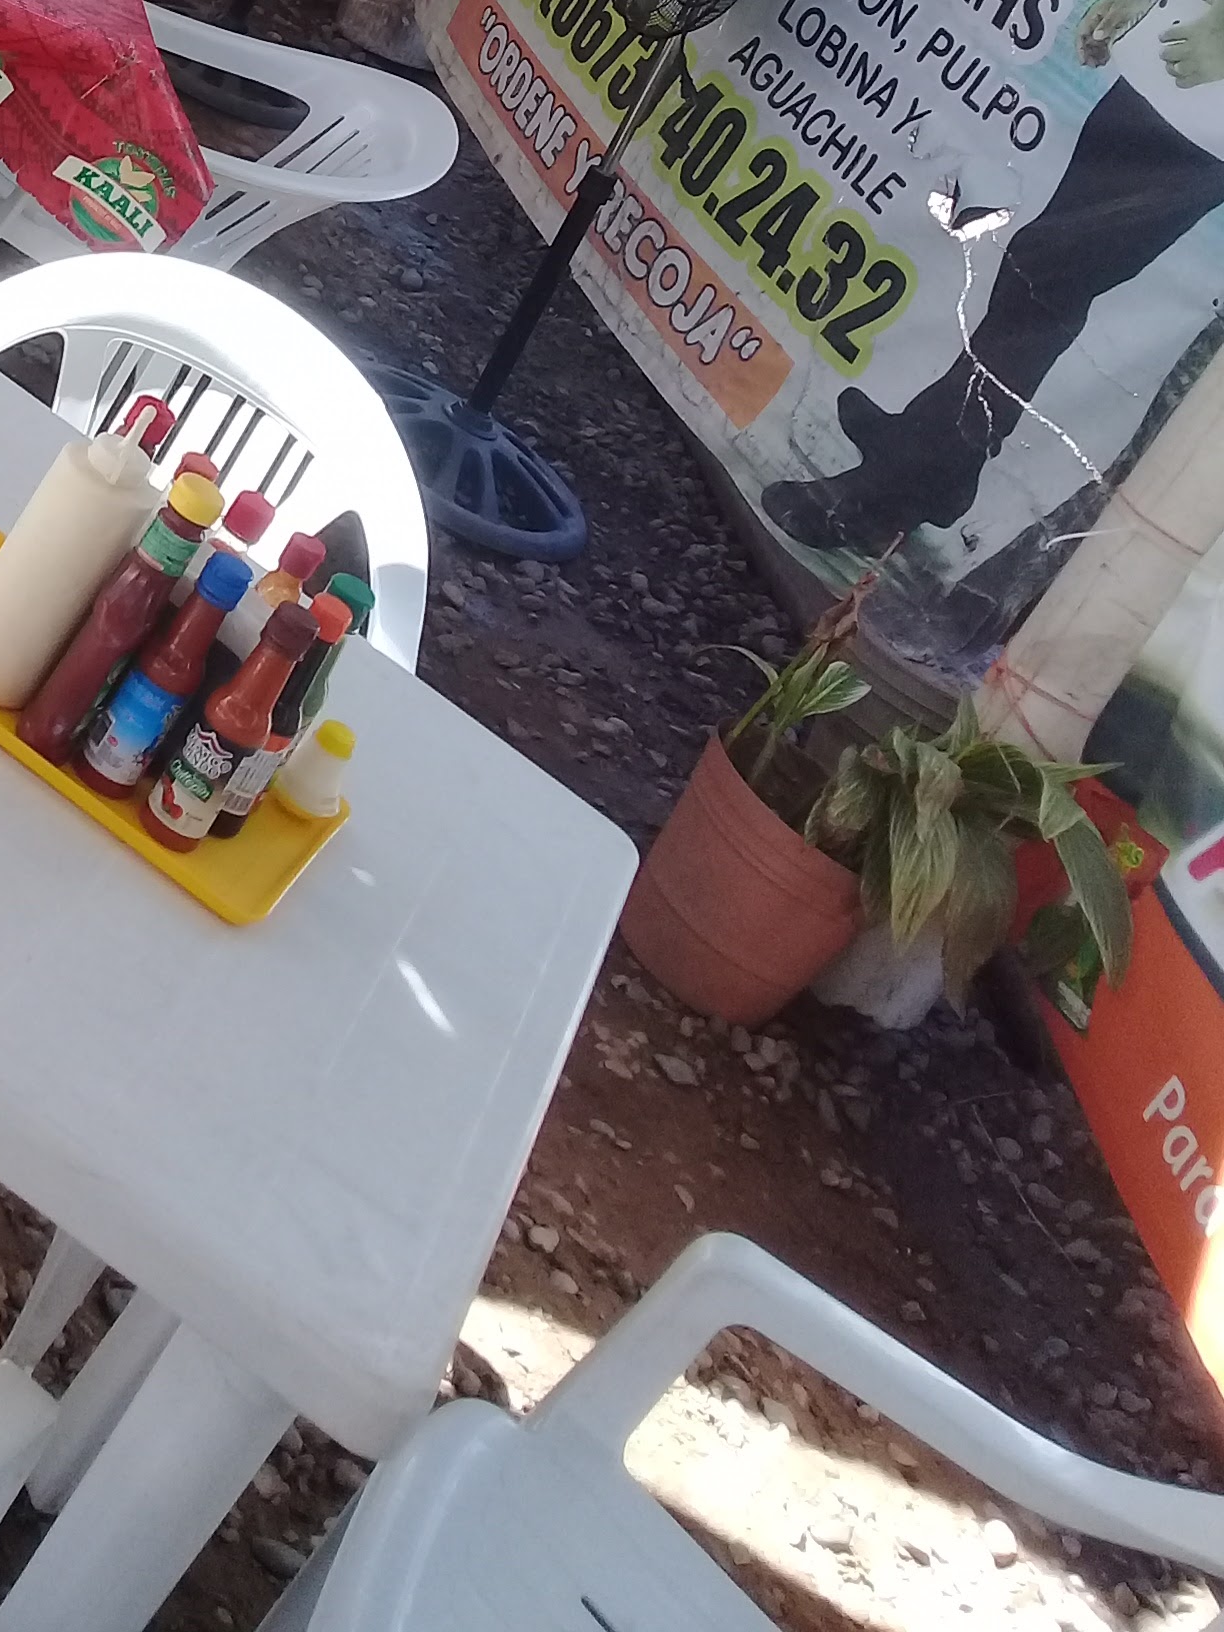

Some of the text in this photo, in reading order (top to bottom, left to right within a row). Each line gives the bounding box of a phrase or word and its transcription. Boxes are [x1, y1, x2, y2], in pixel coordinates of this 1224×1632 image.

[727, 36, 907, 215] AGUACHILE
[891, 96, 933, 135] Y
[917, 27, 1046, 152] PULPO
[73, 166, 154, 239] KAALI
